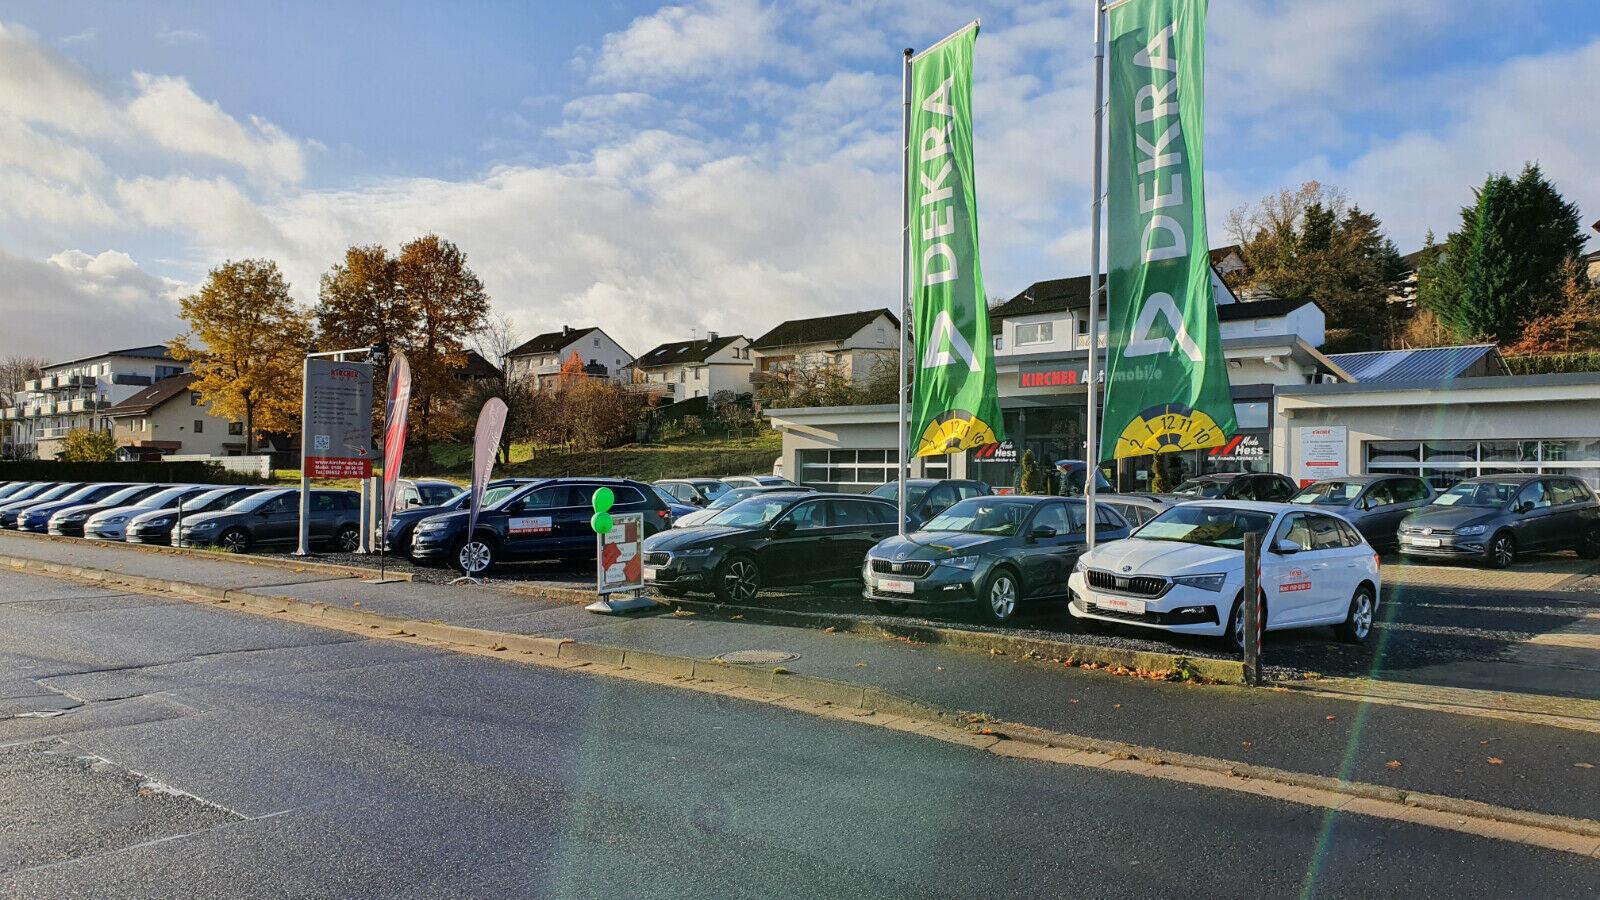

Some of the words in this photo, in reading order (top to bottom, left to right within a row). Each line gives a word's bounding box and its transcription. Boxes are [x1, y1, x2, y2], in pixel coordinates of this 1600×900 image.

[1133, 20, 1187, 264] DEKRA
[921, 74, 959, 287] DEKRA
[1022, 370, 1077, 387] KIRCHER
[1129, 439, 1145, 450] 2
[1145, 424, 1155, 435] 1
[1160, 415, 1176, 430] 12
[1179, 418, 1193, 433] 11
[1193, 427, 1211, 445] 10
[1235, 445, 1264, 455] Hess
[1240, 436, 1260, 447] Mode
[994, 449, 1017, 457] Hess
